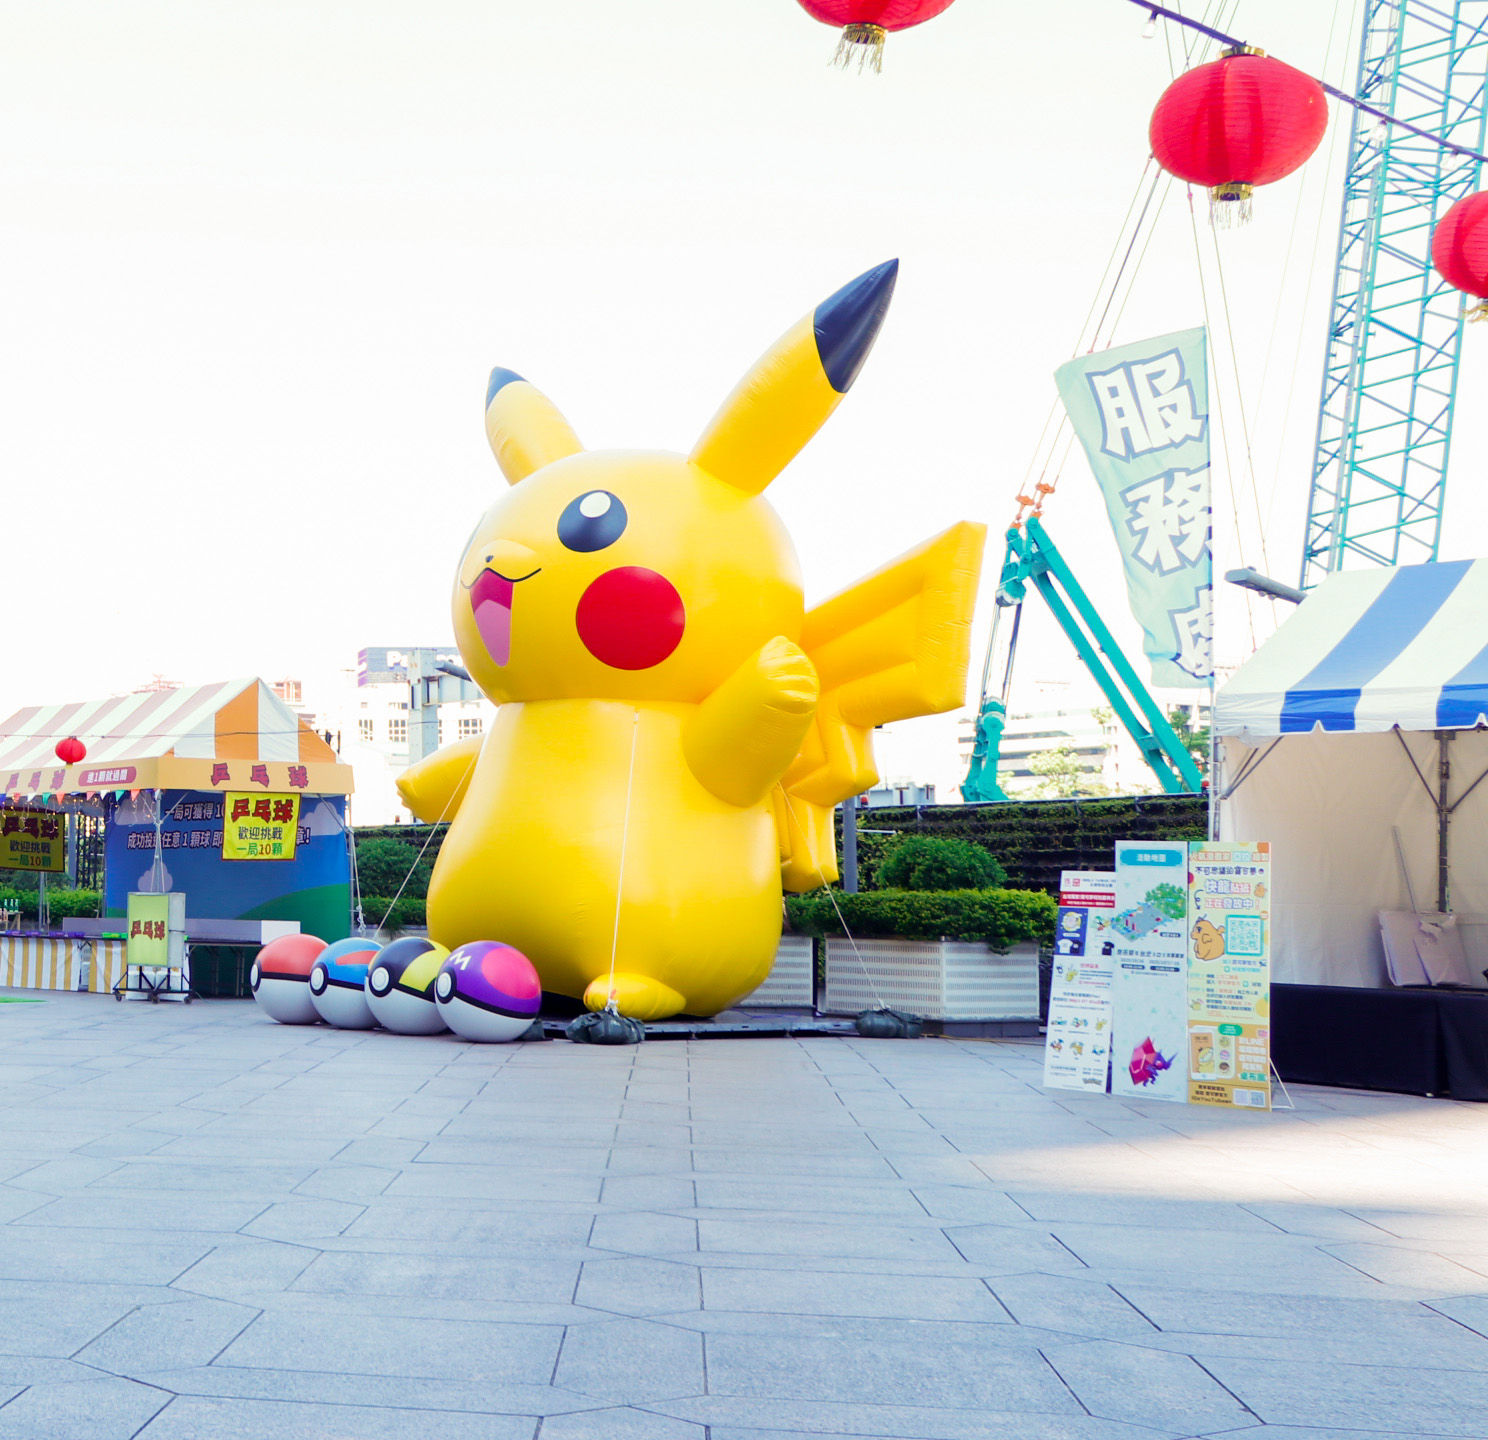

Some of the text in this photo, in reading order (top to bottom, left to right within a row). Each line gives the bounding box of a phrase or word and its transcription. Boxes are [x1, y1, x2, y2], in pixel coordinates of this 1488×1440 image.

[210, 762, 309, 789] 乒乓球
[231, 798, 294, 824] 乒乓球
[238, 826, 283, 841] 歡迎挑戰
[236, 842, 283, 856] 一局10顆
[130, 920, 165, 940] 乒乓球
[450, 950, 472, 971] M
